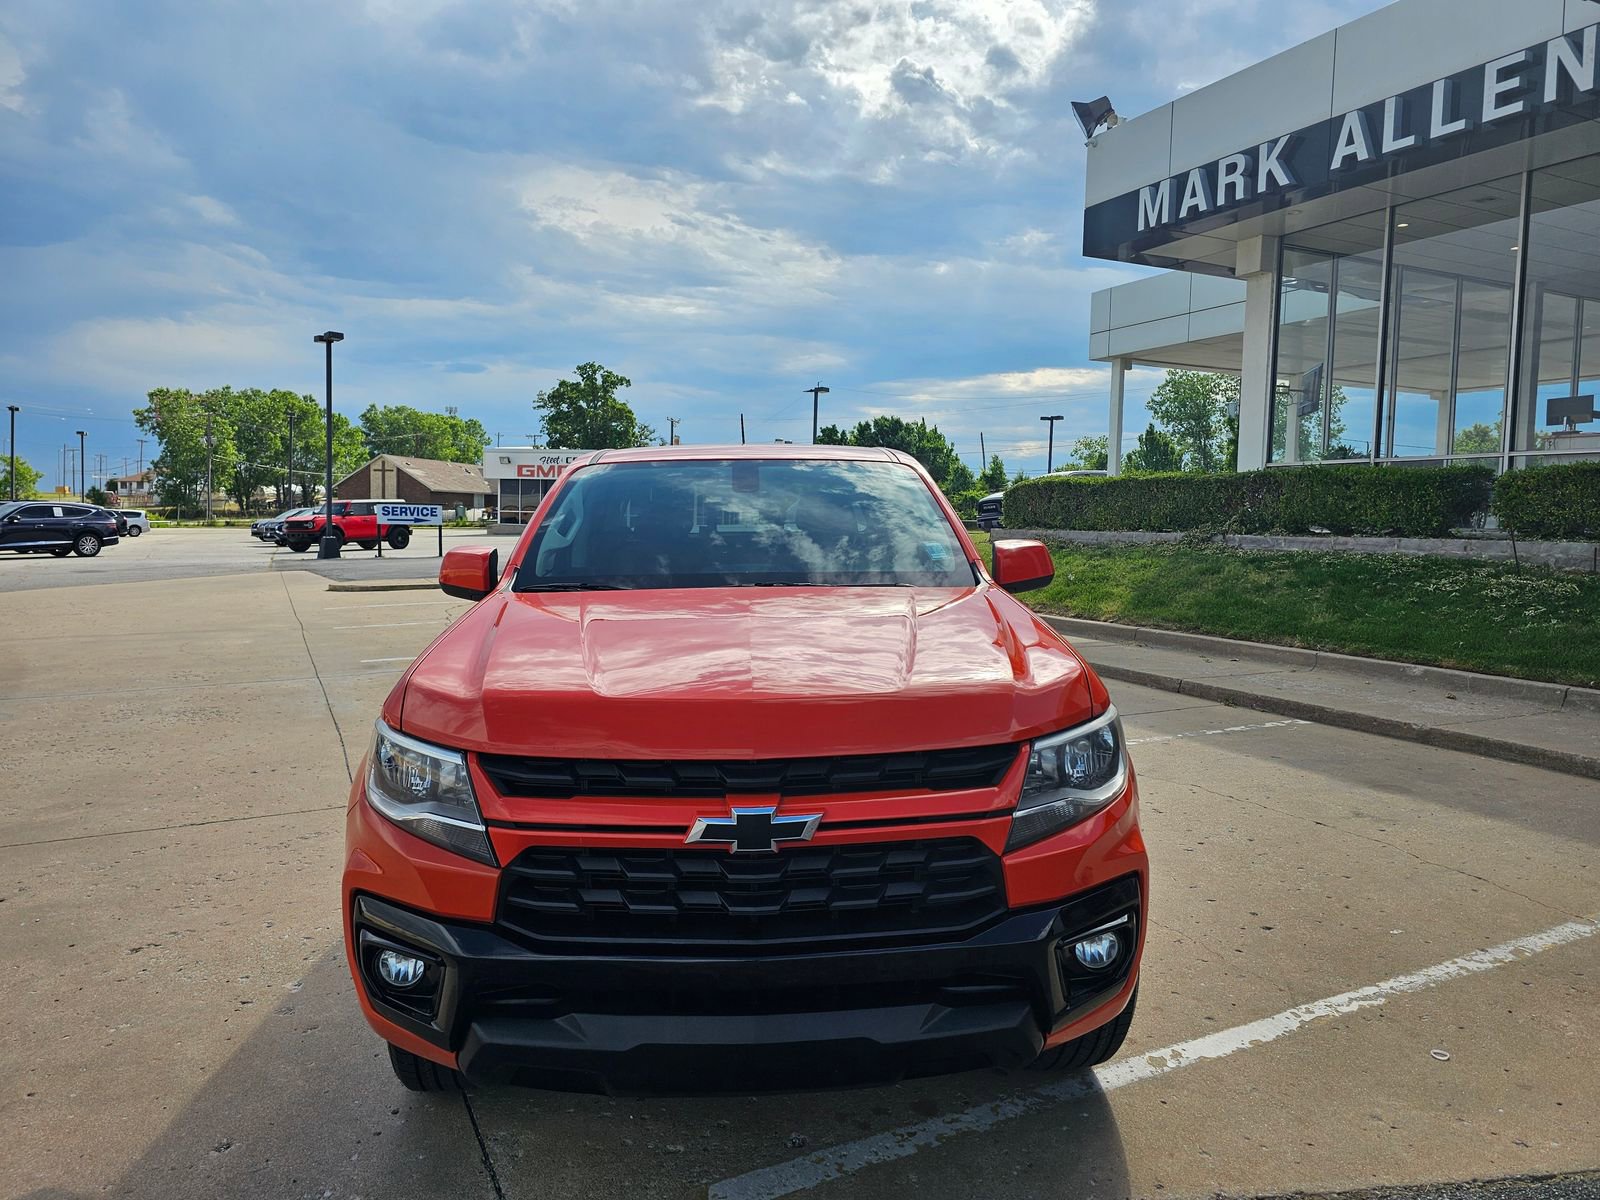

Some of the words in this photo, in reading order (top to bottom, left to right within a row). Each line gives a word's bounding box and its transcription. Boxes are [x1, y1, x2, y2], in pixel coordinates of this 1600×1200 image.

[1138, 134, 1292, 232] MARK
[1330, 25, 1598, 170] ALLEN
[381, 506, 438, 517] SERVICE
